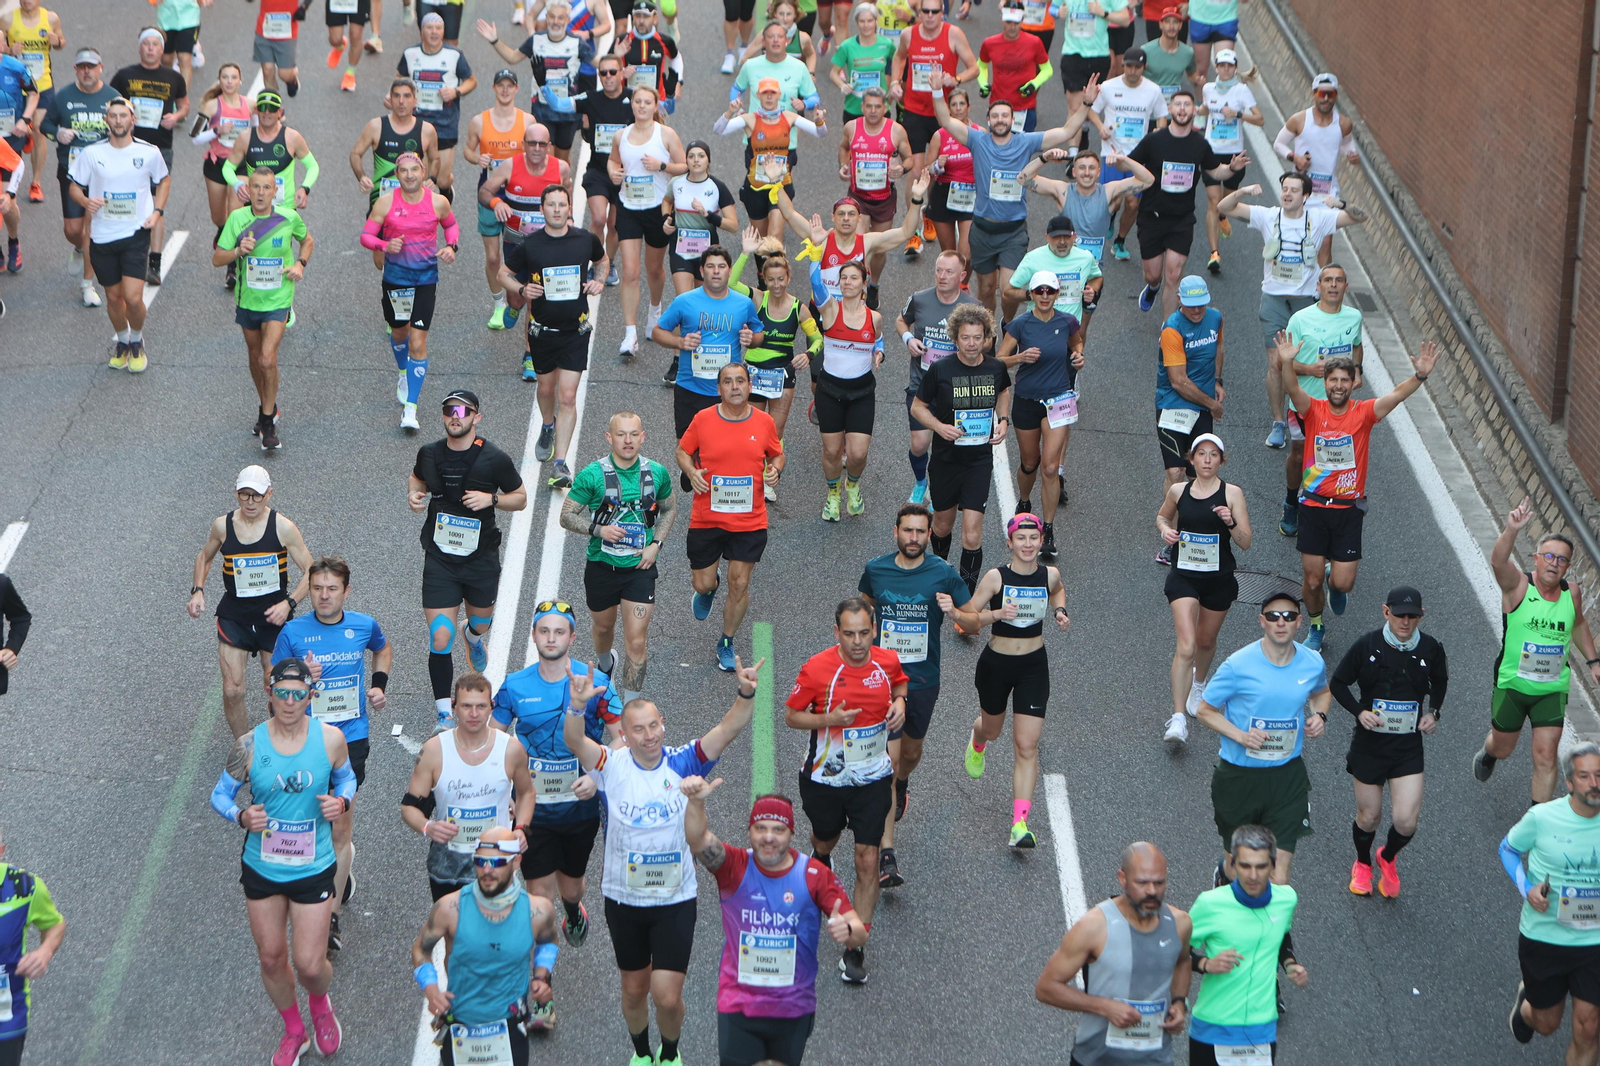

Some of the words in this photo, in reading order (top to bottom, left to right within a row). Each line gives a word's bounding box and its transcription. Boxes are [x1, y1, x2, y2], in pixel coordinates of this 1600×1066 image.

[1114, 105, 1147, 113] VENEZUELA
[78, 112, 89, 122] NO
[556, 267, 576, 275] ZURICH
[1186, 288, 1204, 296] HOKA
[698, 311, 733, 332] RUN
[925, 326, 938, 334] BMW
[1330, 346, 1349, 354] ZURICH
[953, 387, 970, 398] RUN
[971, 385, 995, 397] UTREG
[969, 411, 989, 419] ZURICH
[1326, 439, 1348, 447] ZURICH
[725, 478, 748, 486] ZURICH
[451, 519, 475, 529] ZURICH
[448, 531, 465, 539] 10091
[1191, 536, 1213, 544] ZURICH
[1190, 547, 1205, 555] 10765
[248, 557, 273, 566] ZURICH
[1019, 589, 1043, 598] ZURICH
[896, 611, 928, 619] RUNNERS
[897, 624, 922, 633] ZURICH
[896, 638, 912, 646] 9372
[1538, 646, 1560, 655] ZURICH
[1535, 659, 1550, 667] 9428
[327, 680, 353, 688] ZURICH
[328, 695, 344, 703] 9489
[327, 704, 347, 712] ANDONI
[1388, 703, 1413, 711] ZURICH
[1267, 721, 1293, 730] ZURICH
[860, 725, 884, 738] ZURICH
[545, 763, 572, 773] ZURICH
[270, 771, 314, 795] A&D
[543, 778, 563, 787] 10495
[455, 785, 498, 801] Marathon
[464, 808, 492, 818] ZURICH
[753, 812, 789, 825] WONG
[282, 822, 309, 832] ZURICH
[462, 826, 483, 834] 10992
[280, 838, 298, 847] 7627
[271, 847, 305, 856] LAYERCAKE
[646, 854, 675, 864] ZURICH
[646, 870, 663, 878] 9708
[1580, 889, 1600, 898] ZURIC
[758, 939, 790, 948] ZURICH
[756, 955, 777, 965] 10921
[753, 966, 779, 974] GERMAN
[470, 1025, 500, 1037] ZURICH
[471, 1044, 491, 1053] 10112
